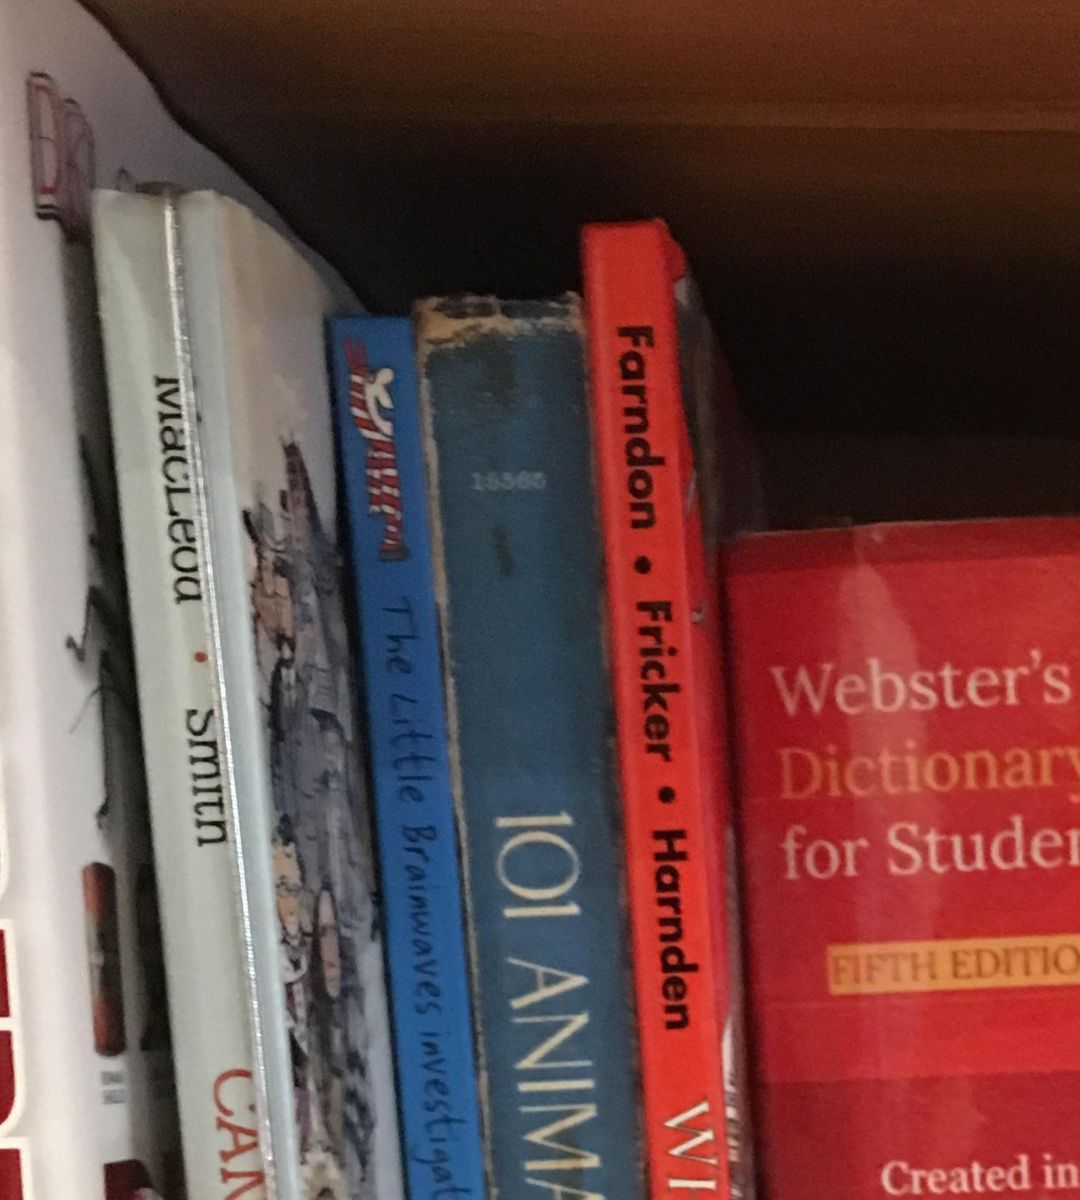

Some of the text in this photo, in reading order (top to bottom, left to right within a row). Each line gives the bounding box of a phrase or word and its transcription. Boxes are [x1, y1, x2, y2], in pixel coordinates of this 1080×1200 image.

[380, 601, 411, 676] The
[616, 325, 699, 1031] Farndon Fricker Harnden
[770, 650, 1072, 717] Webster's
[389, 690, 434, 804] Little
[495, 812, 582, 918] 101
[781, 827, 870, 880] for
[400, 825, 446, 1014] Brainwaves
[831, 948, 938, 987] FIFTH
[880, 1154, 1080, 1197] Created in
